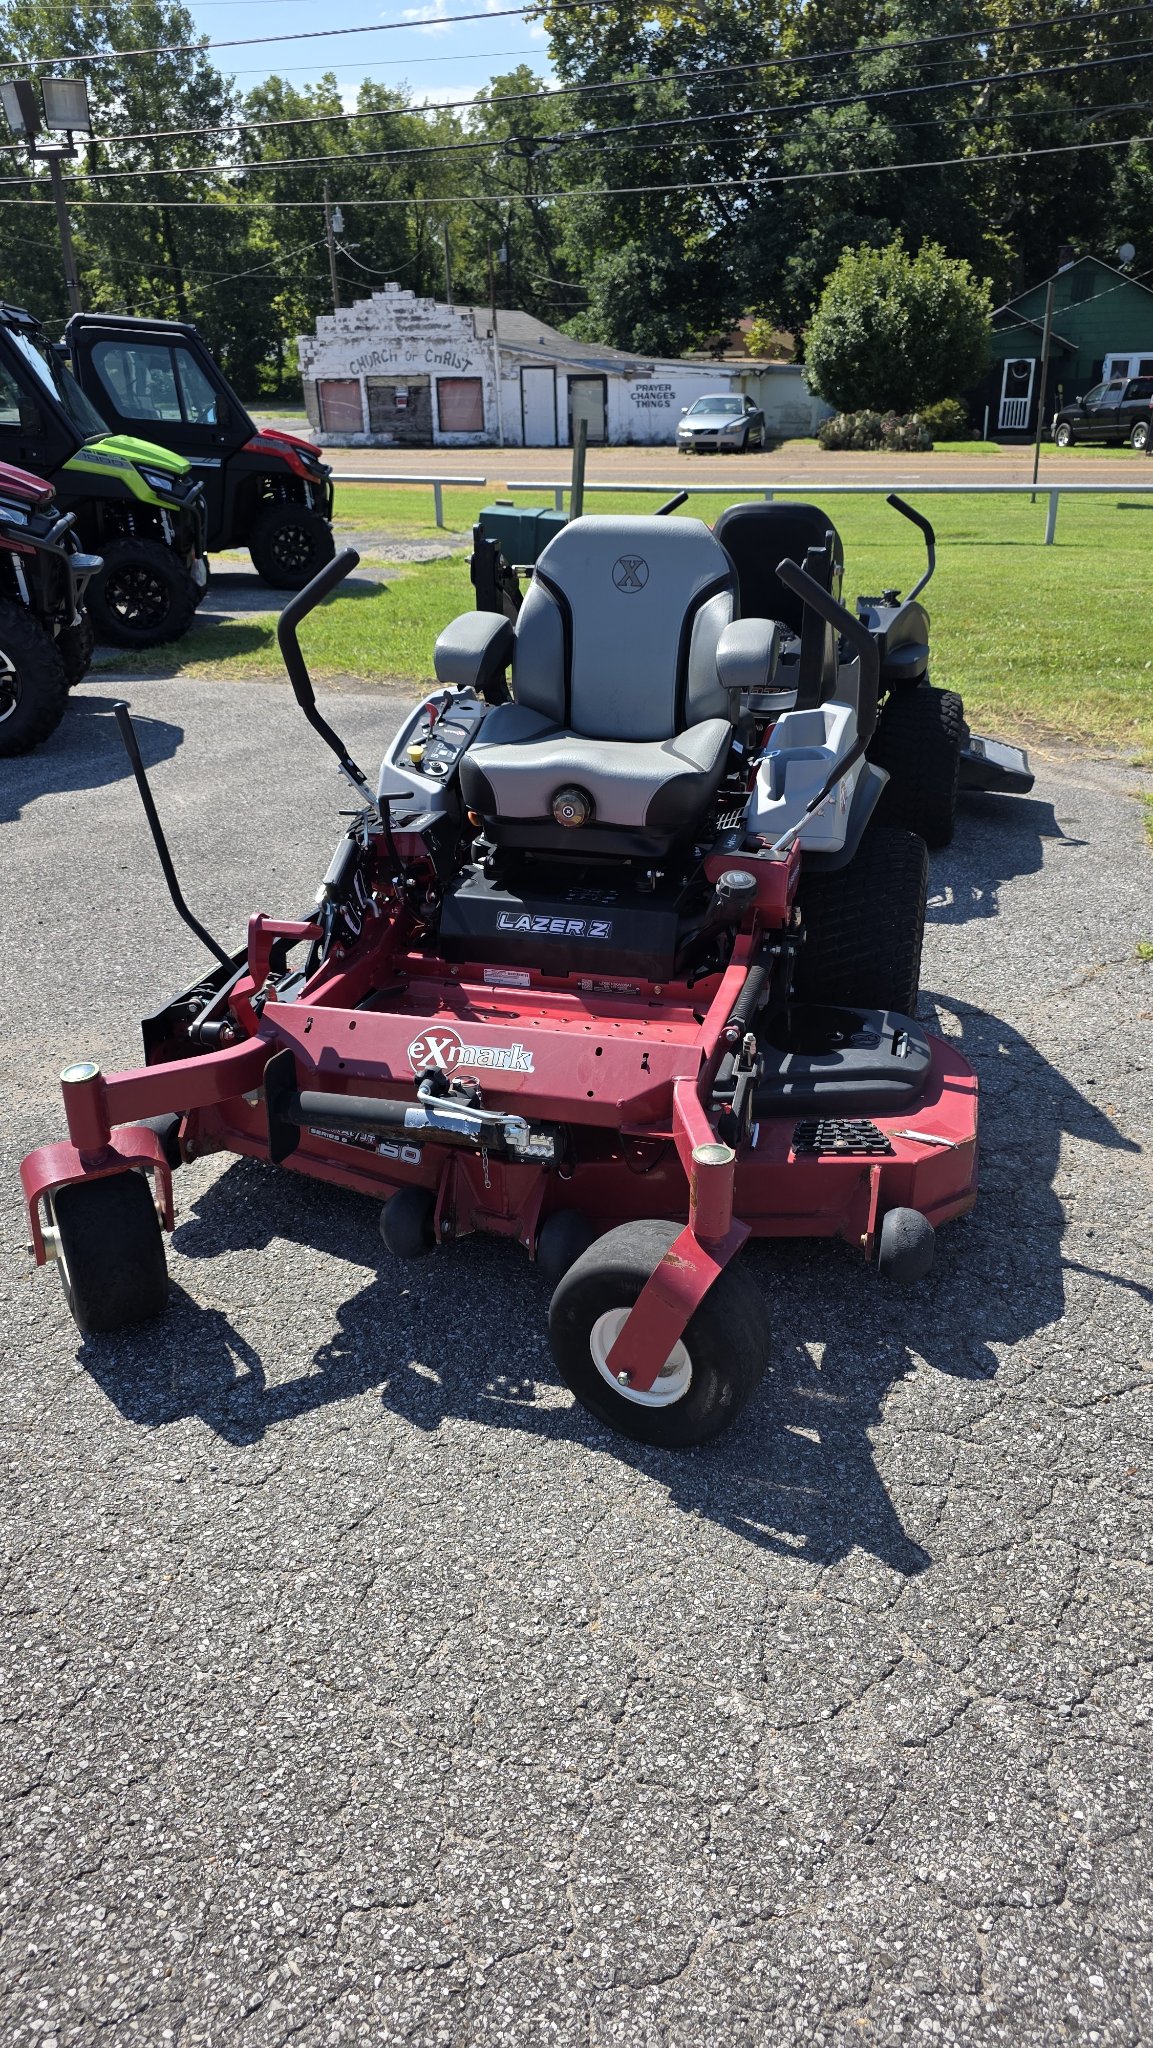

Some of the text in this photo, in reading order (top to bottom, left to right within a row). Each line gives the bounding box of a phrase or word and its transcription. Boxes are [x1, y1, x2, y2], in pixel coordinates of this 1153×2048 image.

[630, 392, 676, 400] CHANGES
[635, 400, 671, 408] THINGS
[616, 558, 645, 588] X
[498, 912, 611, 938] LAZER Z
[408, 1036, 532, 1070] eXmark
